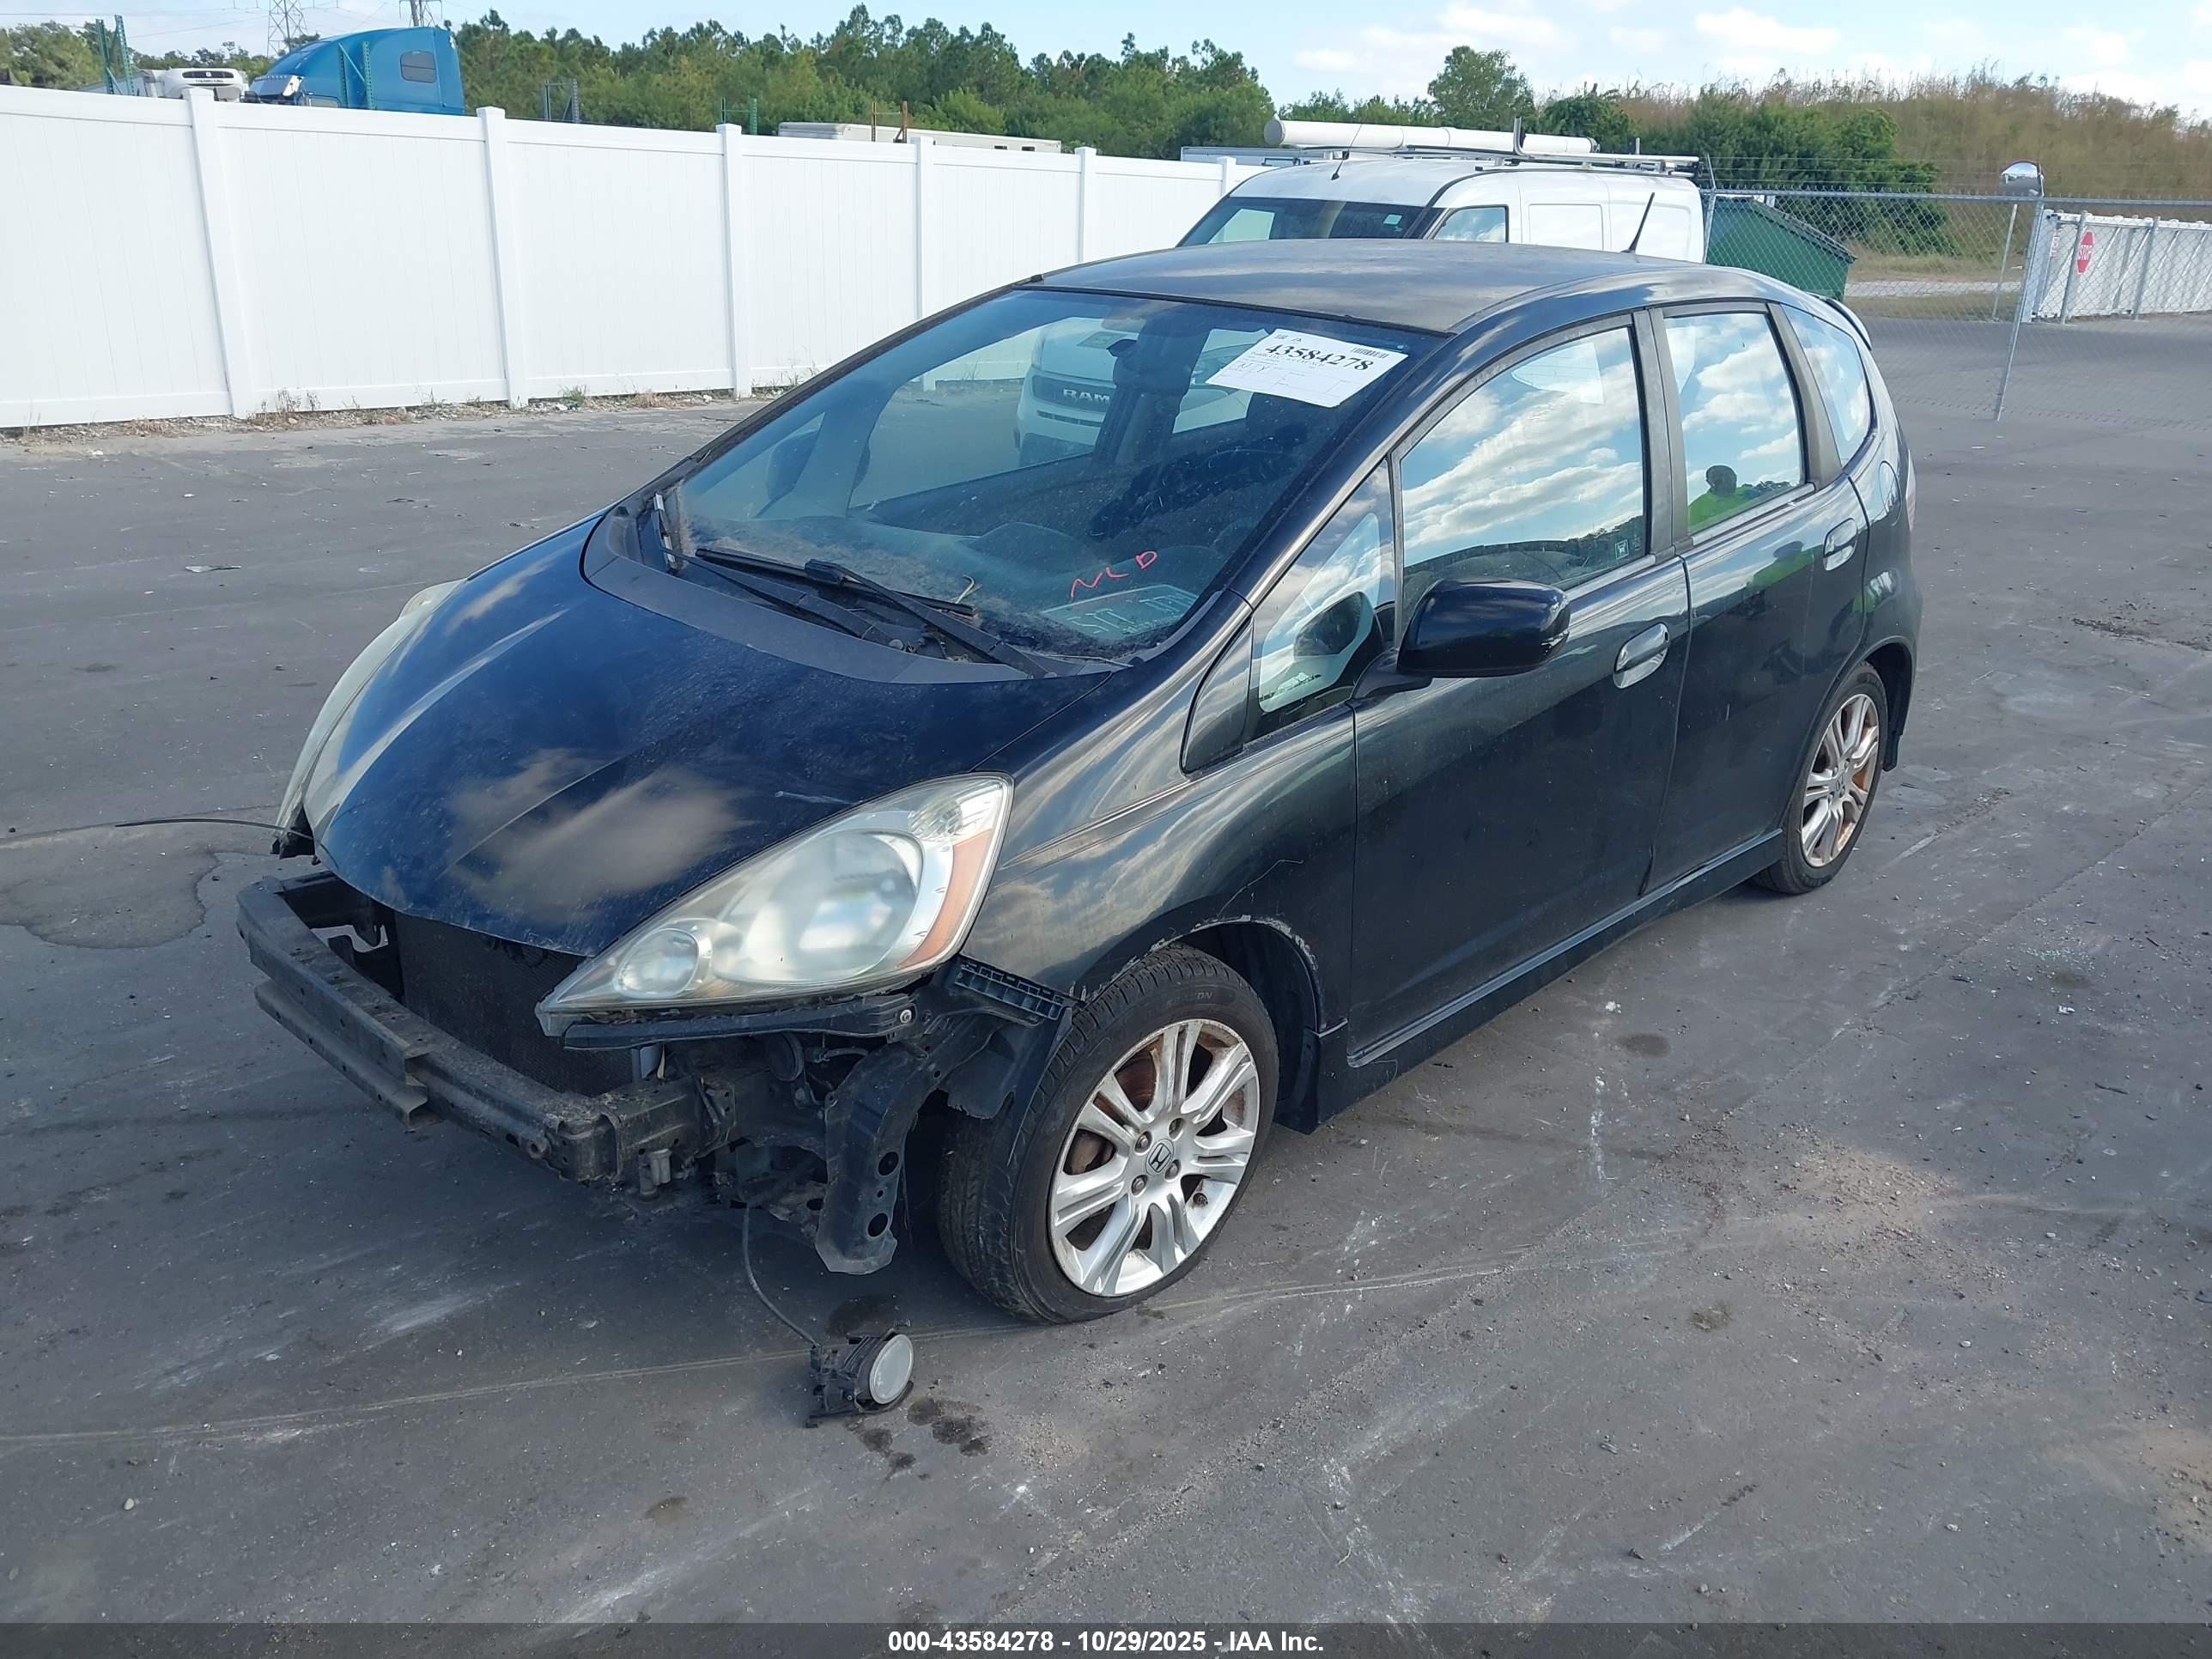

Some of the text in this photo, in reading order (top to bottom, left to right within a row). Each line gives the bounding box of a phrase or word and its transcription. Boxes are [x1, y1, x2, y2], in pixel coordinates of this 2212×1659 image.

[2078, 244, 2093, 261] STOP
[1265, 344, 1374, 370] 43584278
[1063, 389, 1110, 404] RAM
